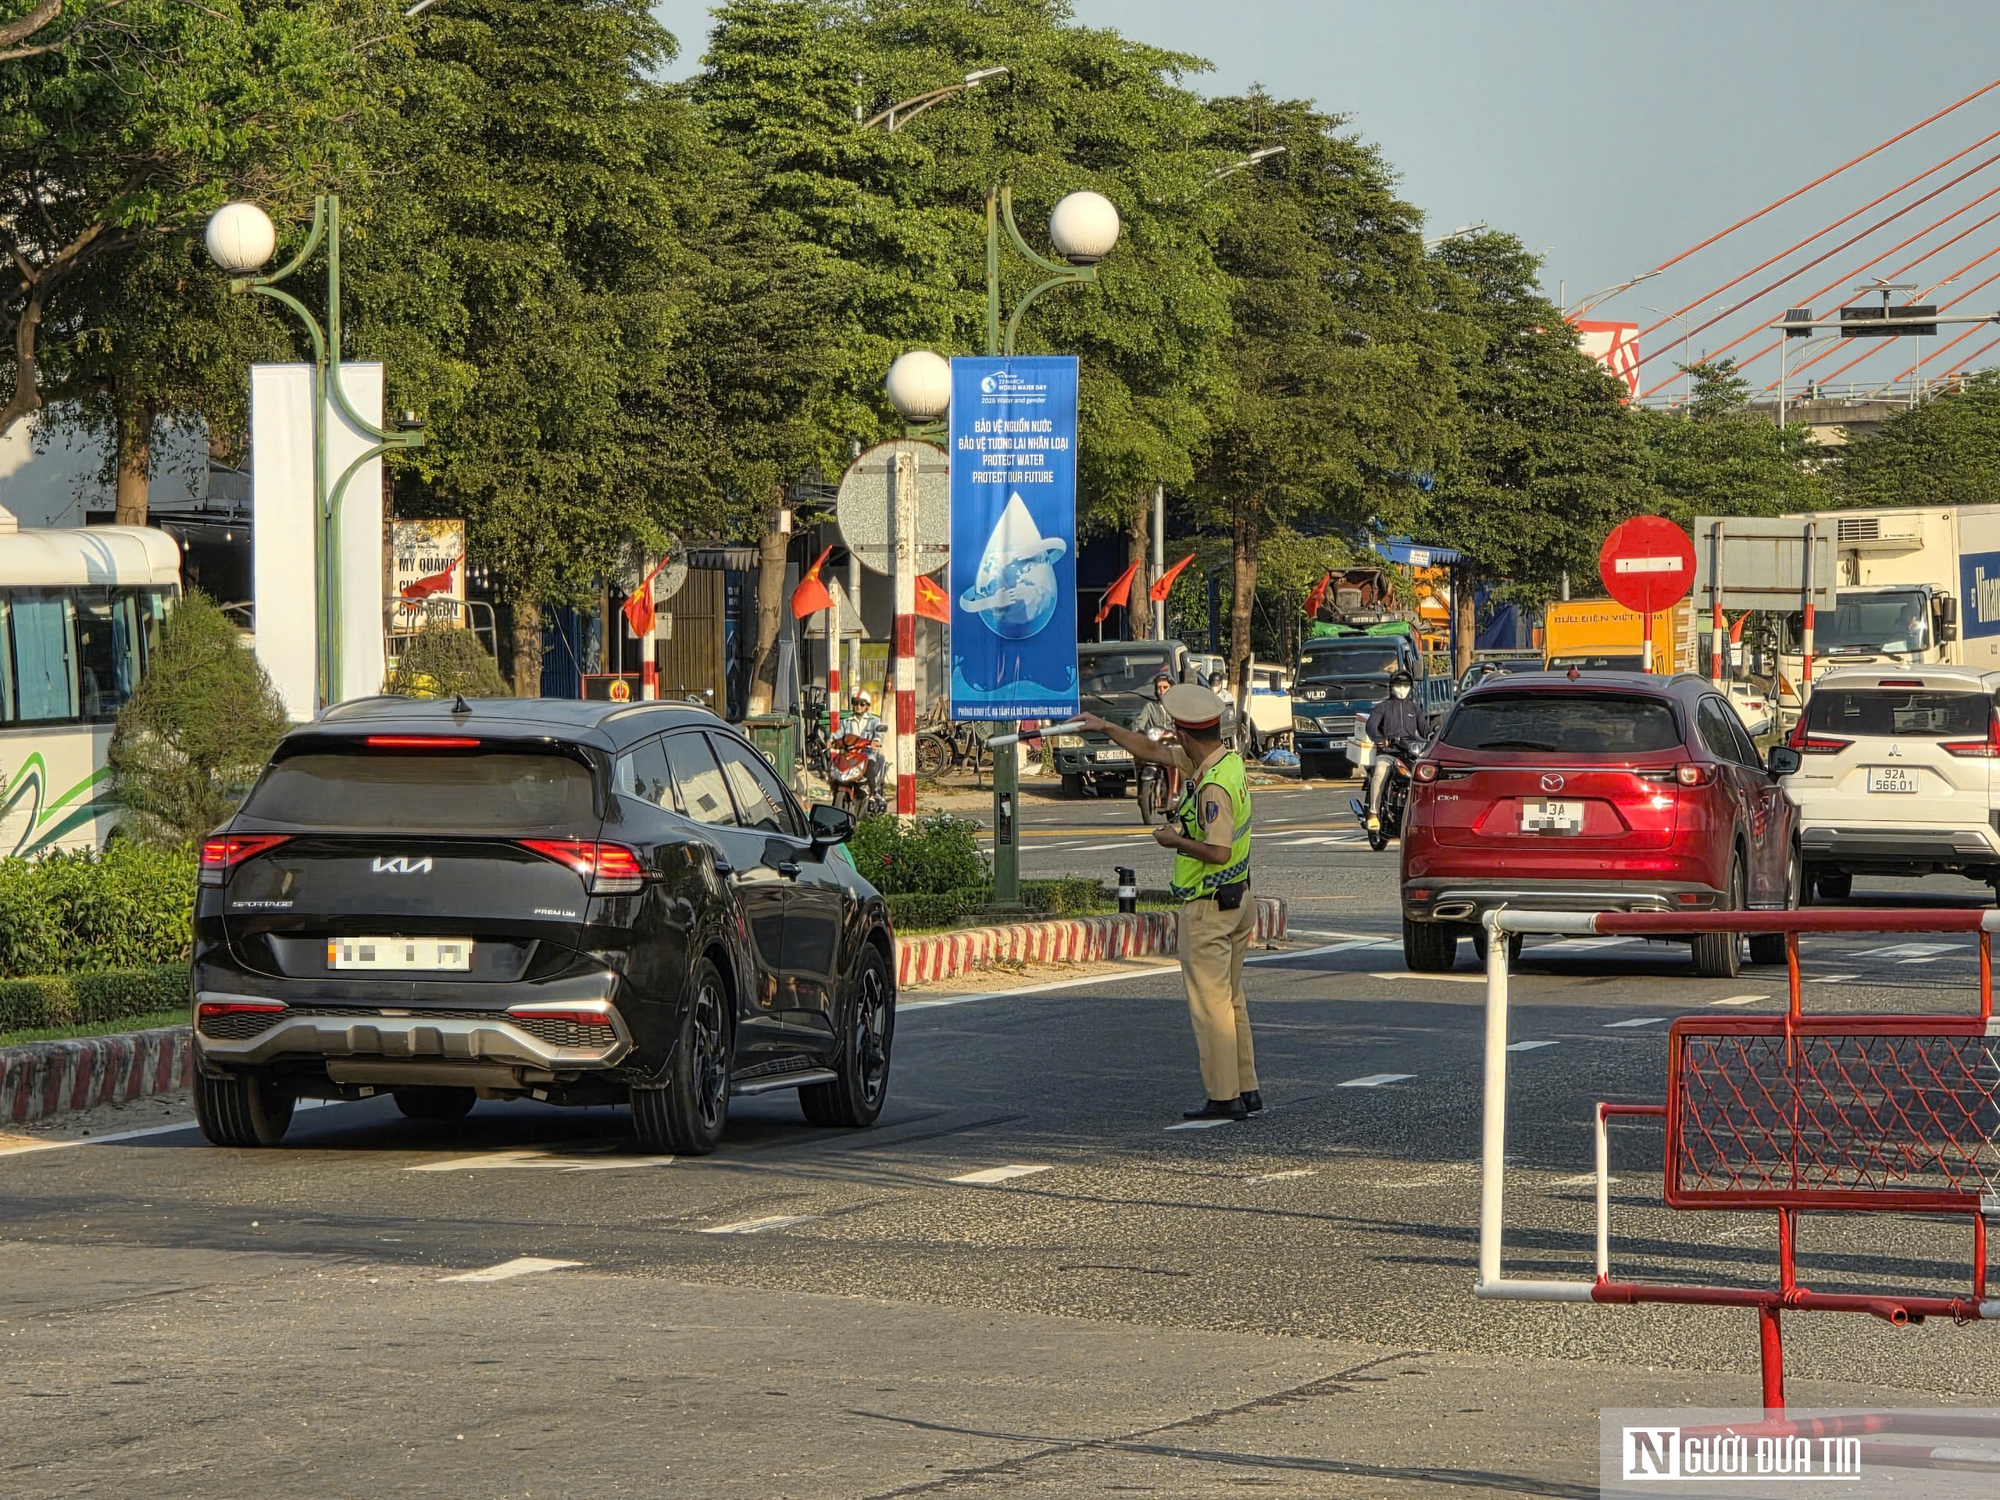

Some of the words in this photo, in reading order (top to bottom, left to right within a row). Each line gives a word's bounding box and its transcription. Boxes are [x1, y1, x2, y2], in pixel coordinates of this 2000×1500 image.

[1026, 397, 1046, 405] gender
[974, 418, 991, 433] BẢO
[993, 418, 1003, 435] VỆ
[958, 435, 974, 450] BẢO
[976, 435, 986, 452] VỆ
[1013, 438, 1026, 450] LAI
[1050, 438, 1069, 452] LOẠI
[982, 454, 1015, 466] PROTECT
[1016, 454, 1044, 466] WATER
[972, 471, 1006, 483] PROTECT
[1007, 471, 1024, 483] OUR
[1024, 471, 1054, 483] FUTURE
[1638, 612, 1663, 622] NM
[1306, 690, 1326, 699] VLXD
[1884, 769, 1905, 779] 92A
[1875, 780, 1913, 790] 566.01
[373, 857, 433, 873] KIA
